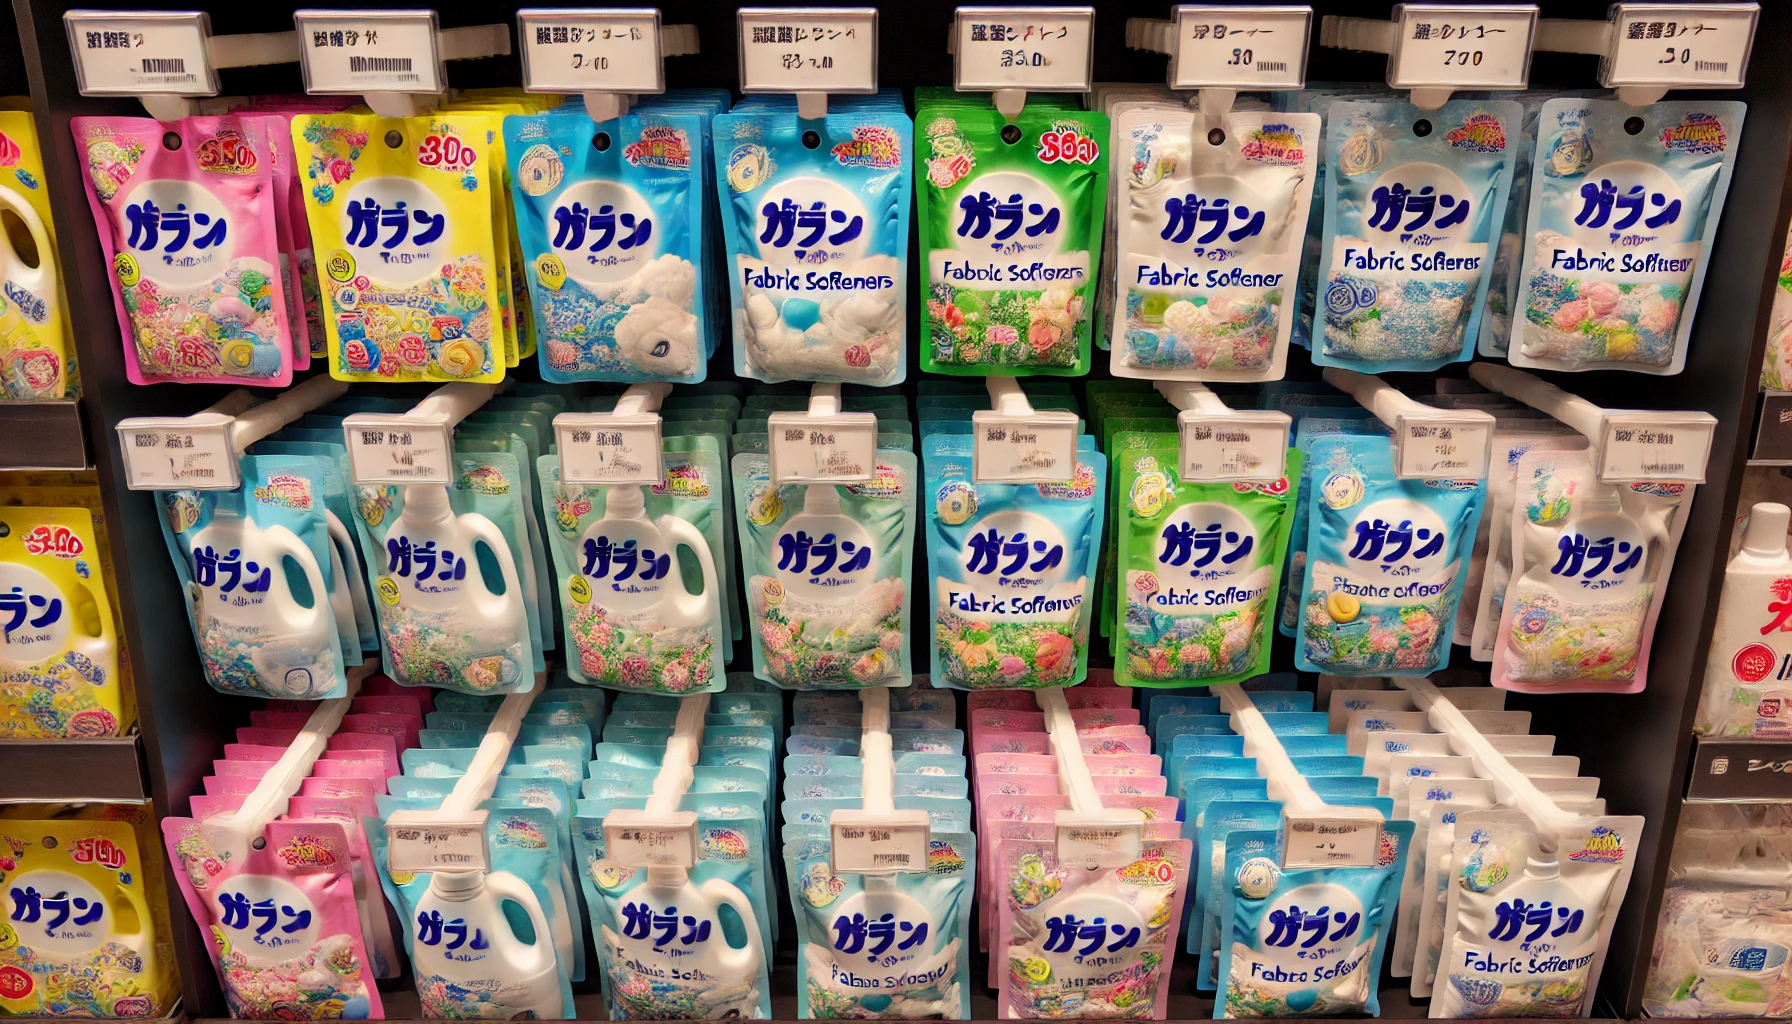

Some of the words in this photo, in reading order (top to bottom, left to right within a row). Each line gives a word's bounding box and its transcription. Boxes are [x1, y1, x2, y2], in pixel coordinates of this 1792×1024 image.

[126, 199, 227, 254] ガラン
[346, 197, 445, 249] ガラン
[552, 201, 652, 251] ガラン
[760, 198, 863, 248] ガラン
[957, 192, 1060, 241] ガラン
[1161, 193, 1265, 244] ガラン
[1368, 182, 1470, 232] ガラン
[1137, 262, 1199, 287] Fabric
[1344, 247, 1405, 270] Fabric
[777, 530, 871, 574] ガラン
[966, 527, 1063, 575] ガラン
[1159, 521, 1253, 570] ガラン
[1551, 533, 1643, 579] ガラン
[219, 891, 312, 937] ガラン
[622, 902, 711, 946] ガラン
[832, 912, 928, 955] ガラン
[1043, 914, 1140, 956] ガラン
[1265, 905, 1361, 948] ガラン
[1488, 898, 1584, 942] ガラン
[1465, 952, 1522, 973] Fabric
